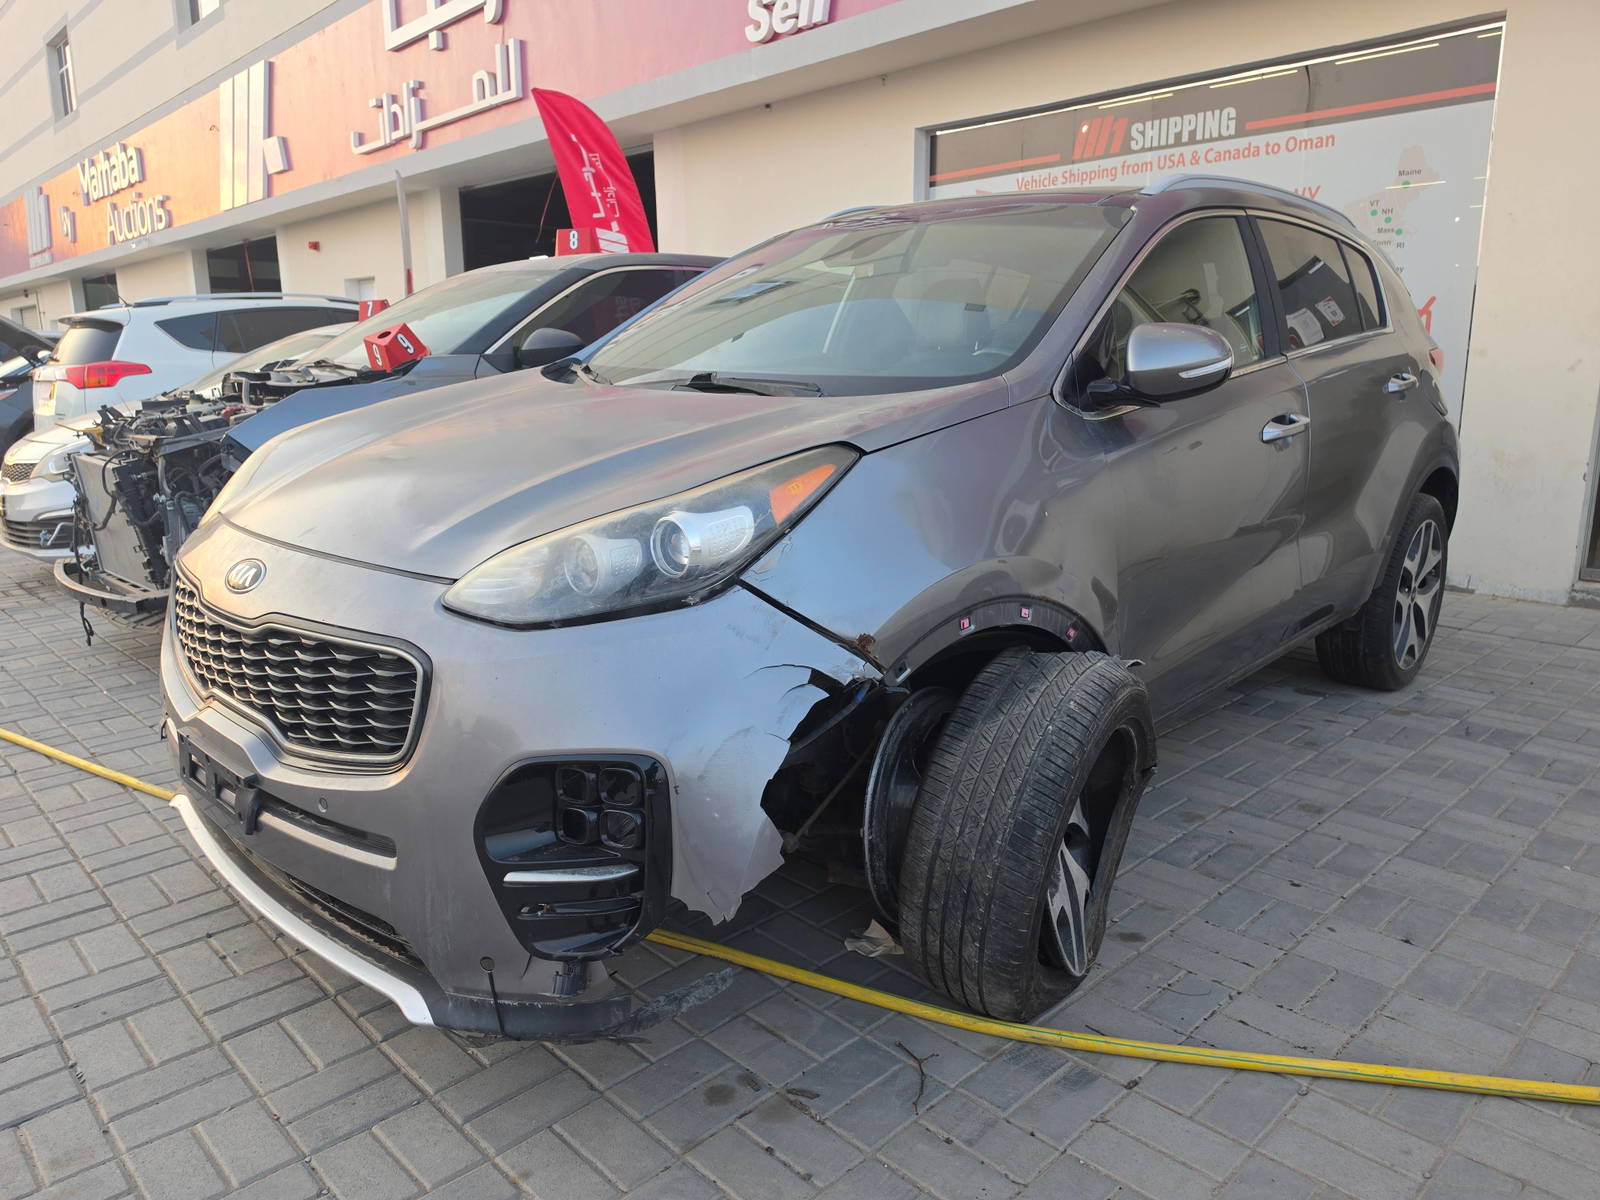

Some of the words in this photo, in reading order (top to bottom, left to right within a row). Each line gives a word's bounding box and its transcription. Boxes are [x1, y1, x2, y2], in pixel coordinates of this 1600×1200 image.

[1130, 107, 1237, 150] SHIPPING
[1016, 172, 1059, 191] Vehicle
[1061, 166, 1118, 185] Shipping
[1121, 160, 1153, 176] from
[1157, 152, 1185, 170] USA
[1190, 150, 1200, 166] &
[1204, 141, 1261, 164] Canada
[1264, 141, 1281, 156] to
[1285, 134, 1336, 153] Oman
[1398, 168, 1422, 177] Maine
[106, 193, 171, 246] Auctions
[569, 230, 579, 250] 8
[367, 301, 374, 318] 7
[372, 343, 383, 366] 9
[397, 333, 415, 354] 9
